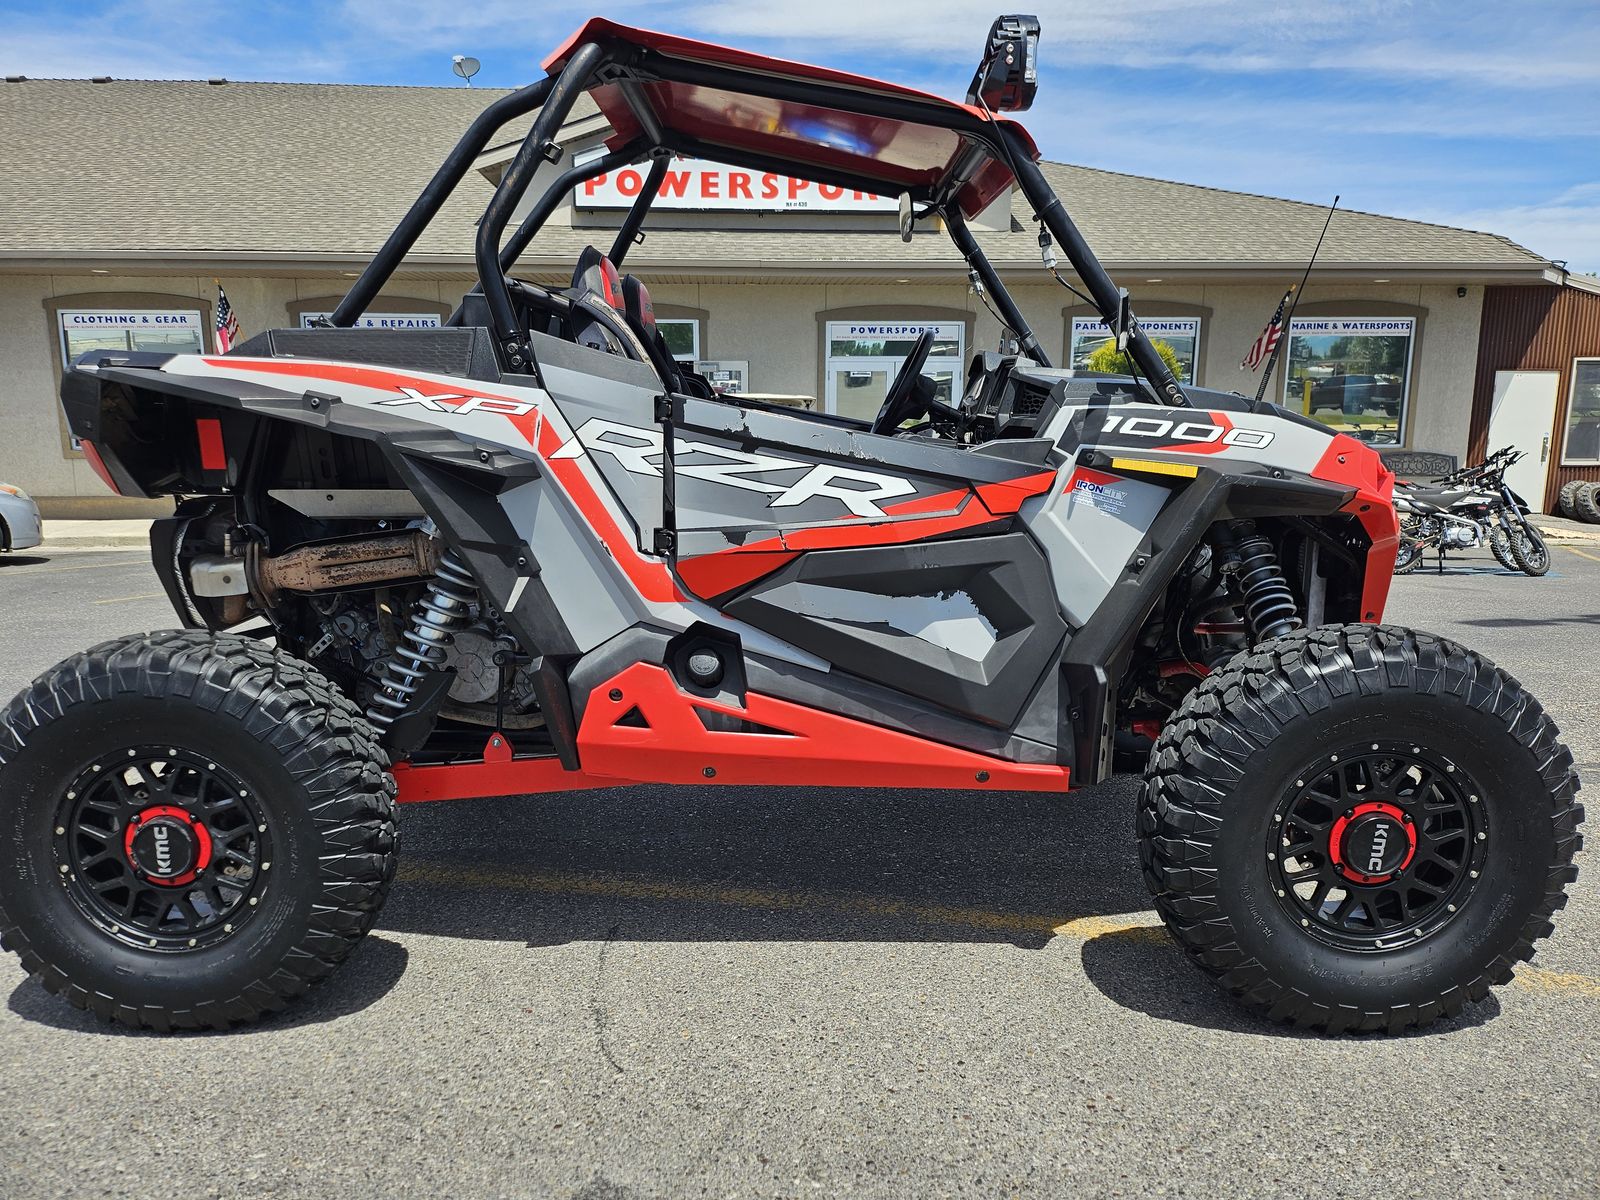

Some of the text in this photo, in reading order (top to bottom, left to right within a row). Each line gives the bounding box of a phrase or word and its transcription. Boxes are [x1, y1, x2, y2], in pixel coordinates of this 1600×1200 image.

[73, 315, 188, 324] CLOTHING & GEAR
[366, 319, 374, 328] &
[381, 319, 437, 328] REPAIRS
[850, 326, 940, 335] POWERSPORS
[1075, 322, 1194, 331] PARTS MPONENTS
[1291, 322, 1410, 330] MARINE & WATERSPORTS
[370, 386, 538, 416] XP
[1101, 415, 1276, 450] 1000
[549, 417, 919, 518] RZR
